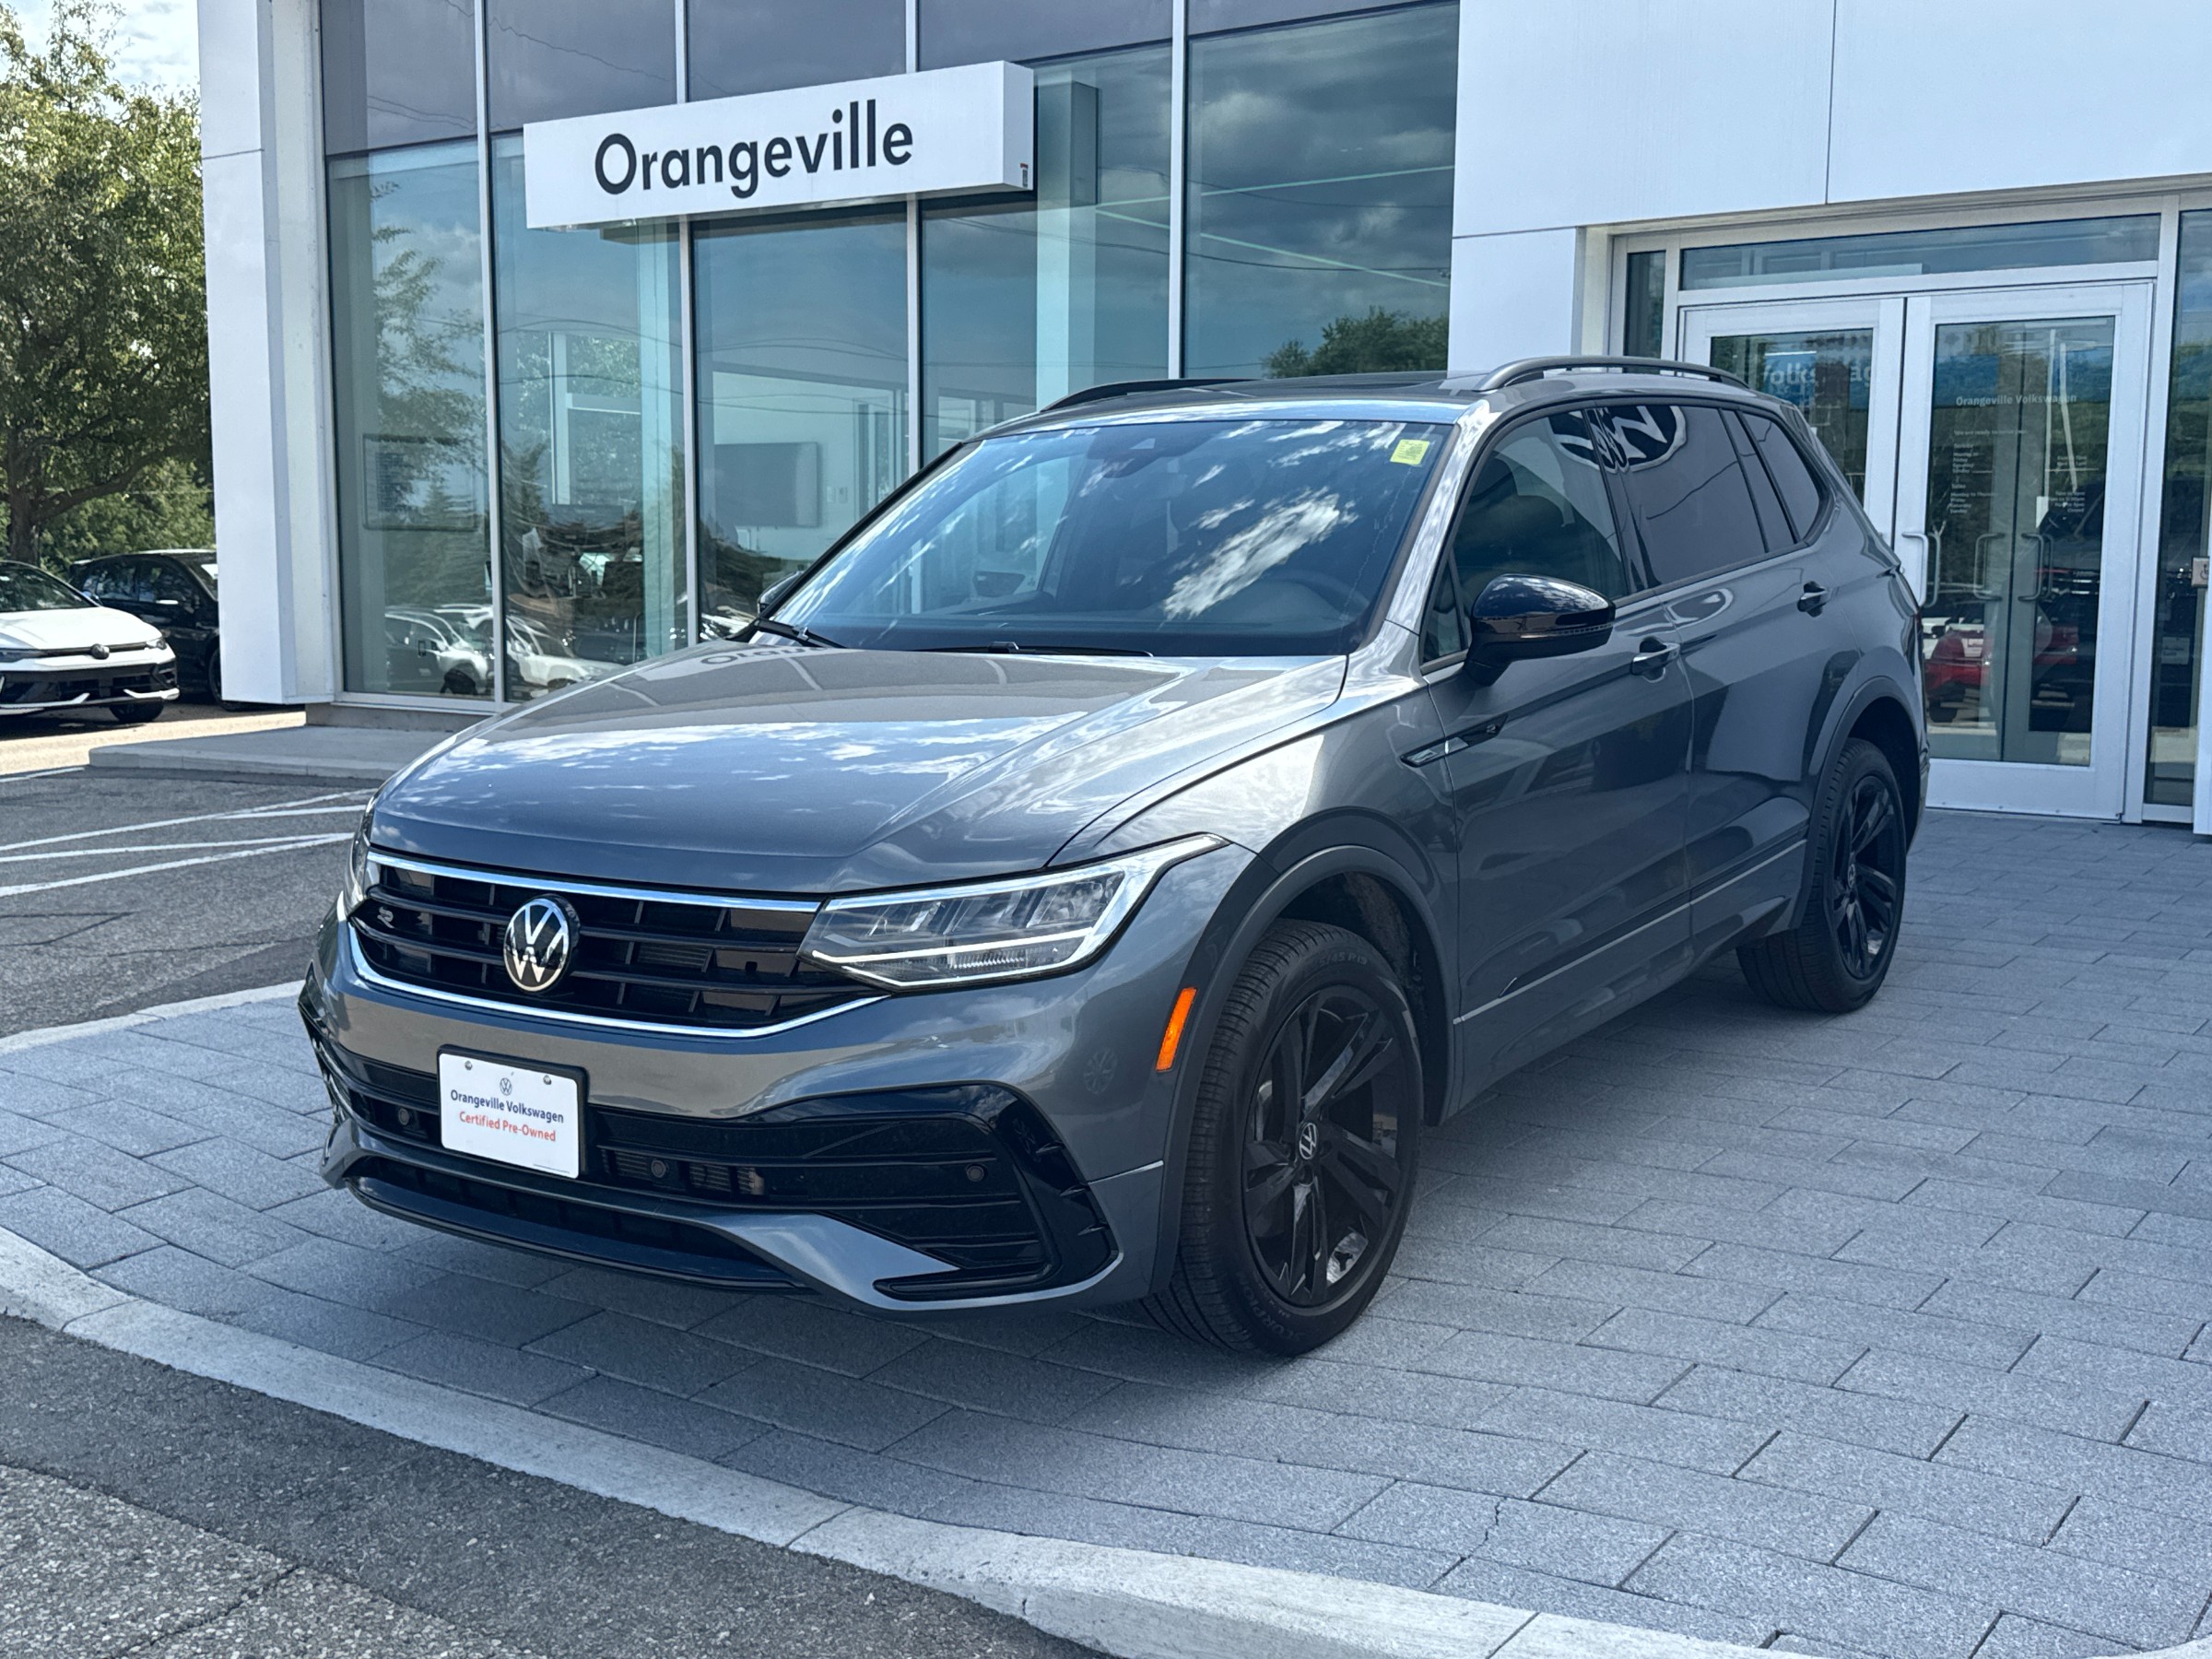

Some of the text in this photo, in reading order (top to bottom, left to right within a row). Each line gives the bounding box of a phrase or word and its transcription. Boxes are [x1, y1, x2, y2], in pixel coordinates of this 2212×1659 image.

[594, 99, 913, 199] Orangeville
[1956, 395, 2013, 407] Orangeville
[451, 1089, 564, 1124] Orangeville Volkswagen
[459, 1111, 557, 1142] Certified Pre-Owned
